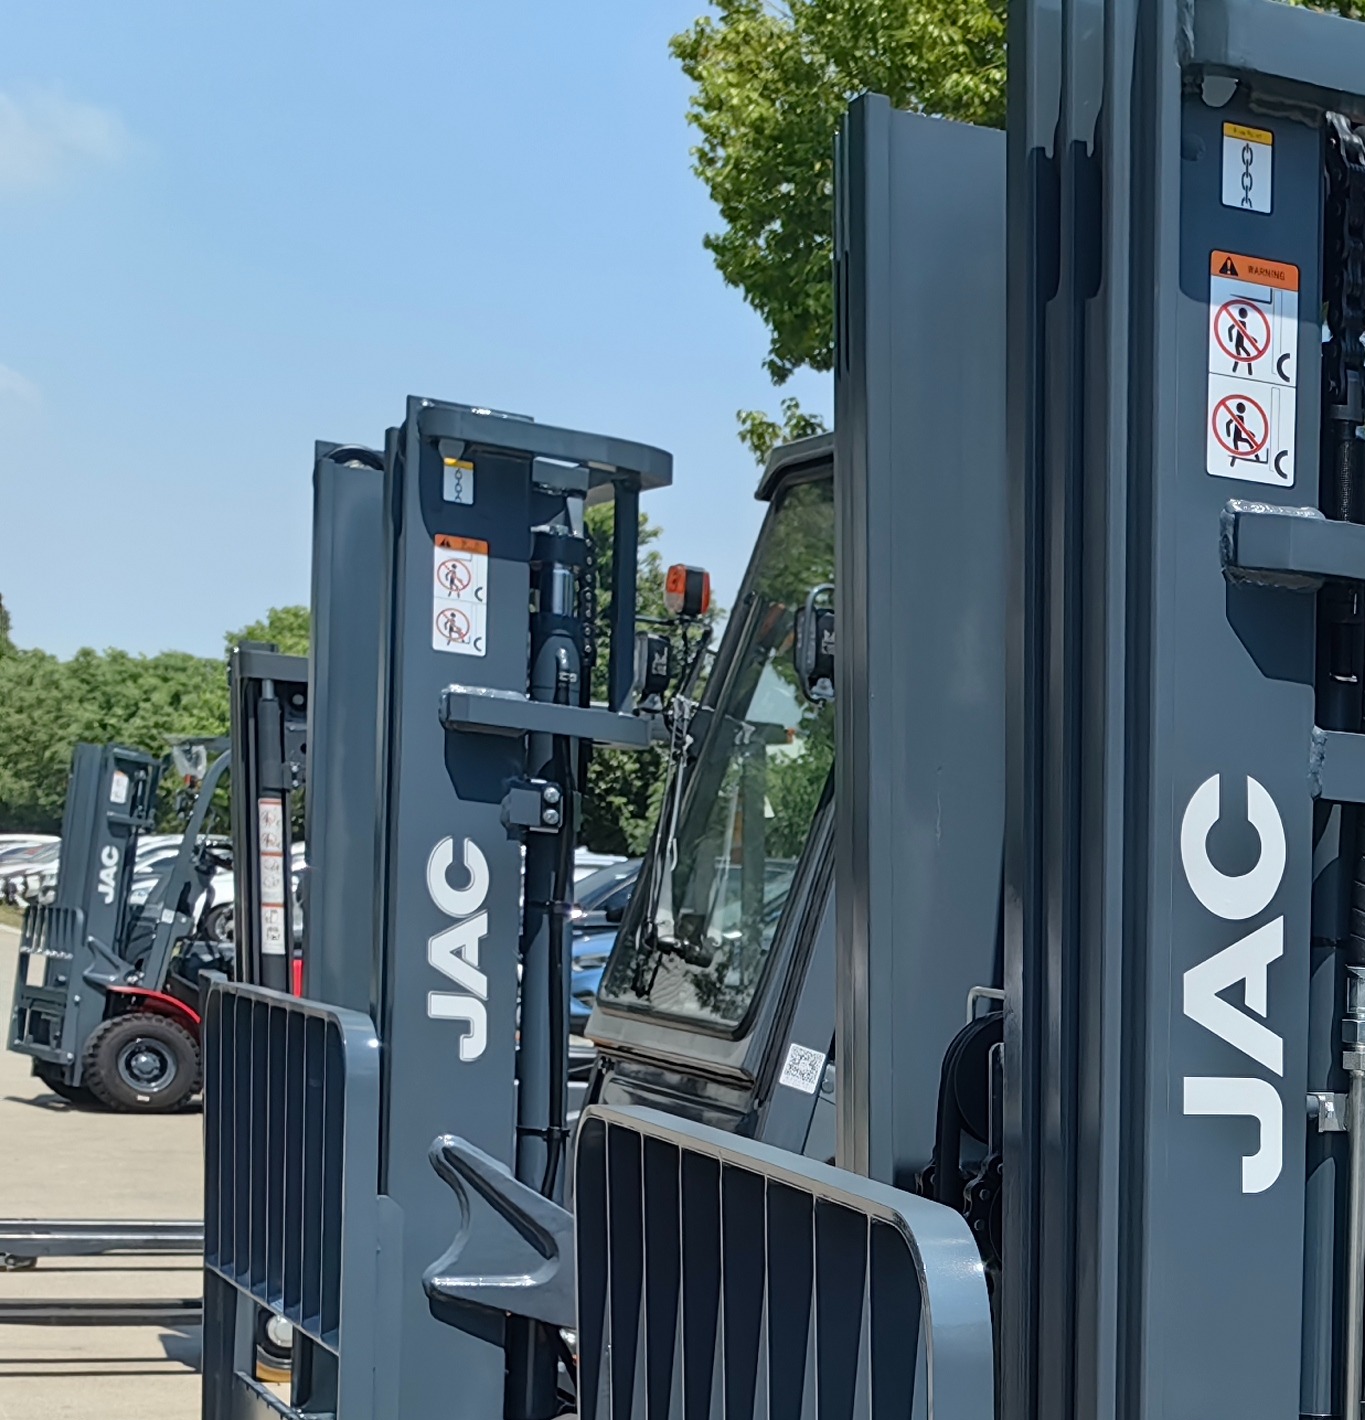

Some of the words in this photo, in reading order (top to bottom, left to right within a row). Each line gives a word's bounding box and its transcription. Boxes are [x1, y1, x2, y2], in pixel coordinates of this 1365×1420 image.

[1247, 264, 1286, 282] WARNING
[98, 845, 119, 904] JAC
[427, 835, 490, 1062] JAC
[1180, 772, 1287, 1195] JAC
